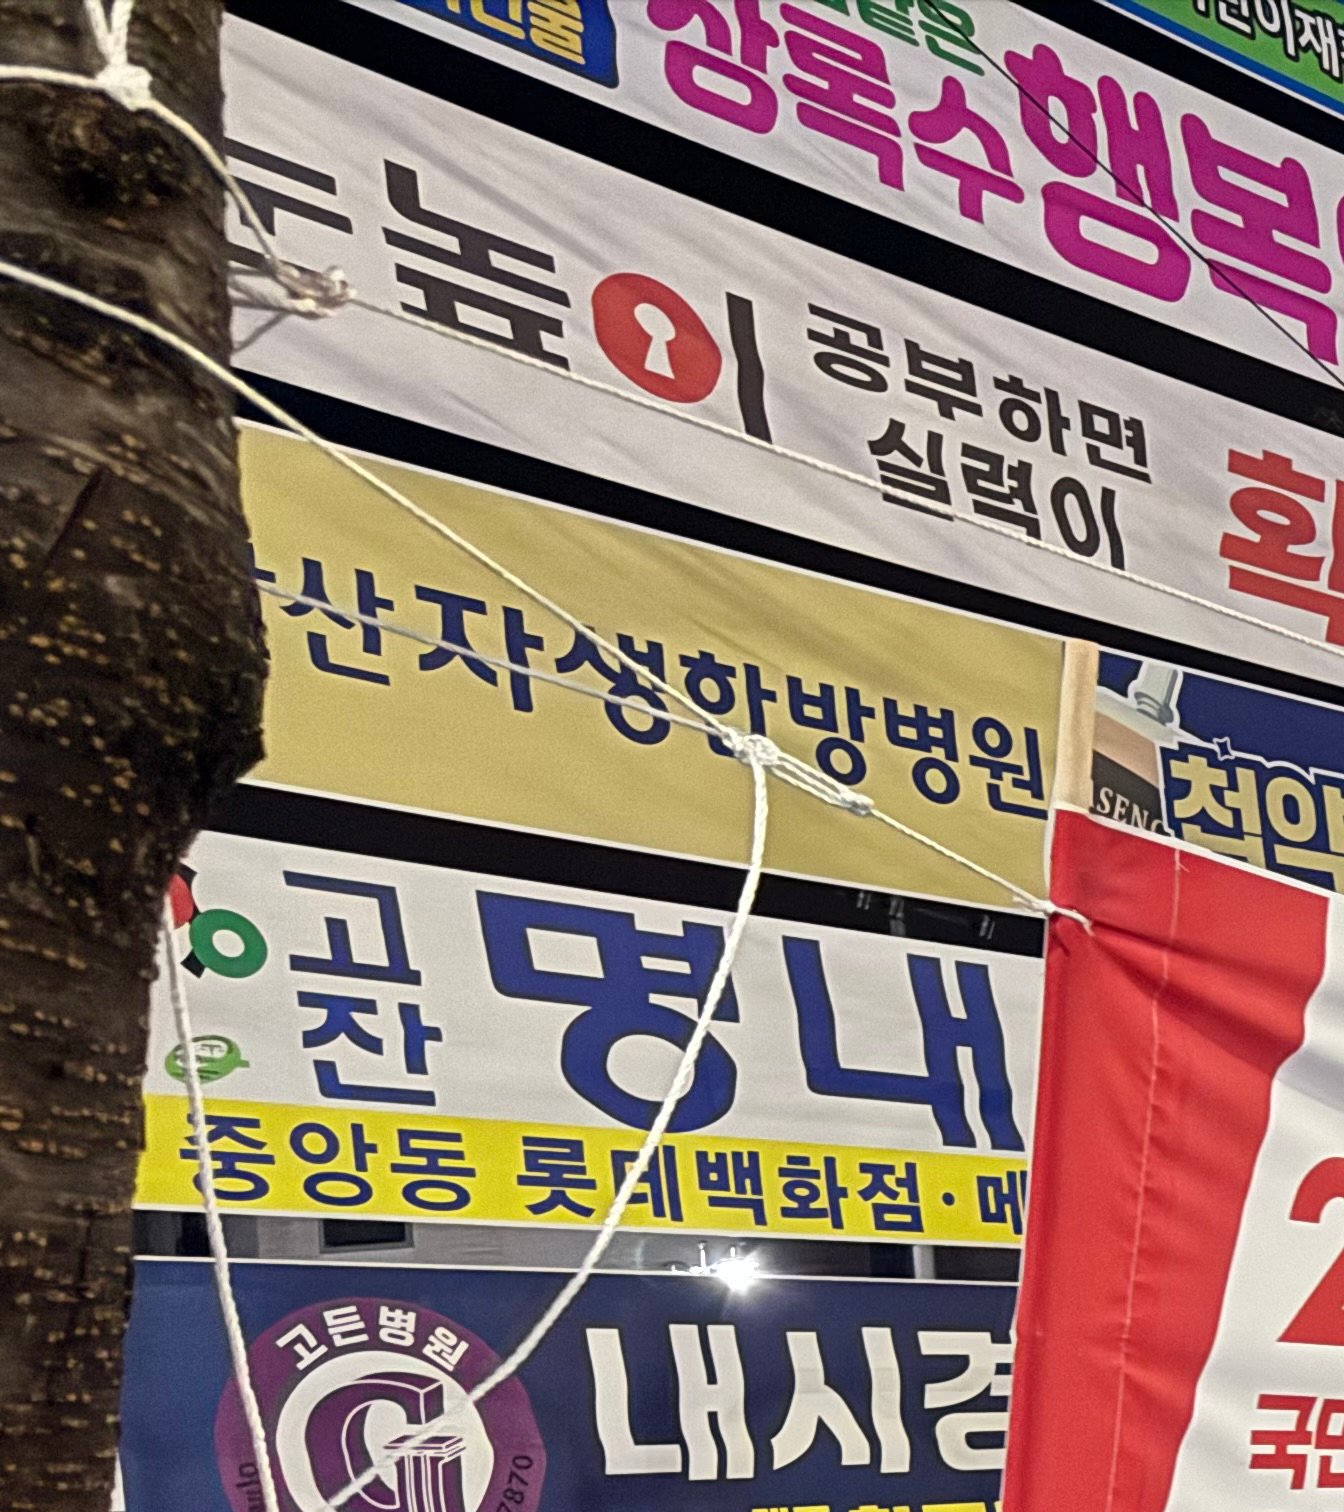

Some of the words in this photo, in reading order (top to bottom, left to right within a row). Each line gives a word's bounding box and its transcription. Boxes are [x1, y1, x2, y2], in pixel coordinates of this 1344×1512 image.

[807, 302, 1153, 485] 공부하면
[867, 417, 1127, 570] 실력이
[177, 1112, 478, 1211] 중앙동
[275, 1304, 470, 1372] 고든병원
